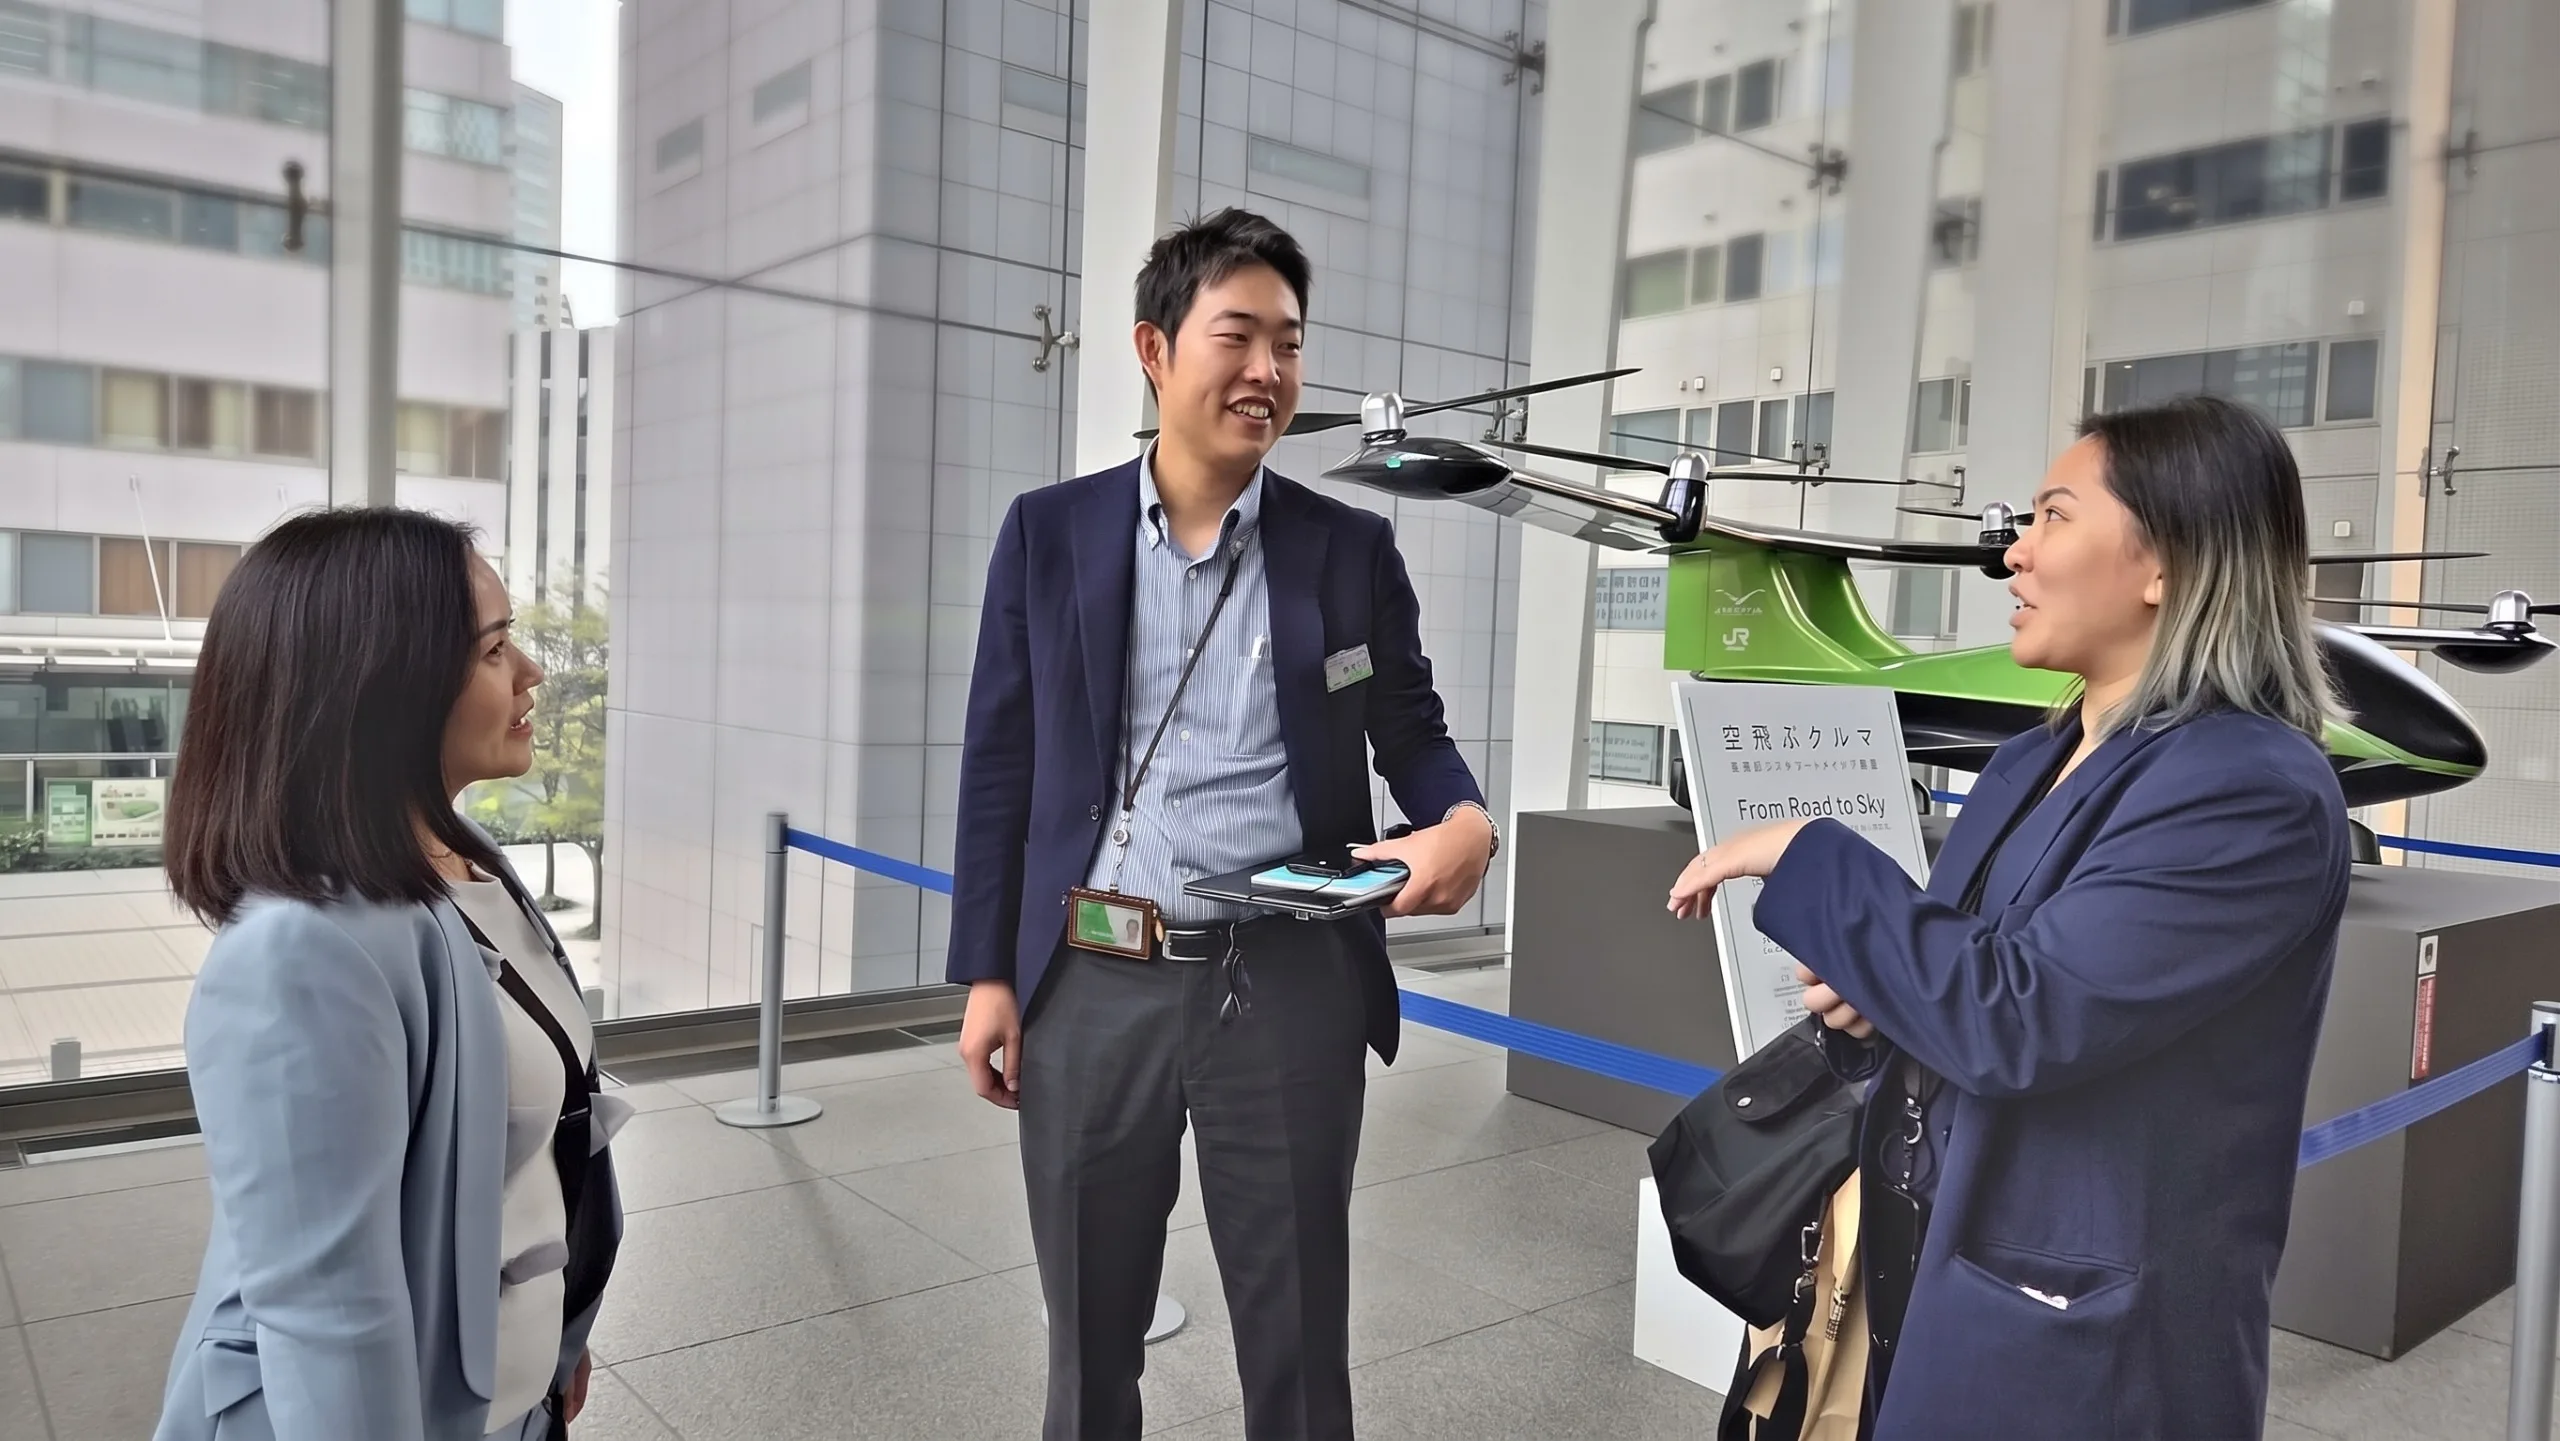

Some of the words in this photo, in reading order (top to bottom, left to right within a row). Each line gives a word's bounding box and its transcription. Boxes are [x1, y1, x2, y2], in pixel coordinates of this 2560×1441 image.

[1722, 627, 1749, 646] JR
[1722, 724, 1872, 750] 空飛ぶクルマ
[1738, 798, 1784, 820] From
[1788, 796, 1832, 818] Road
[1837, 796, 1853, 815] to
[1857, 793, 1885, 818] Sky
